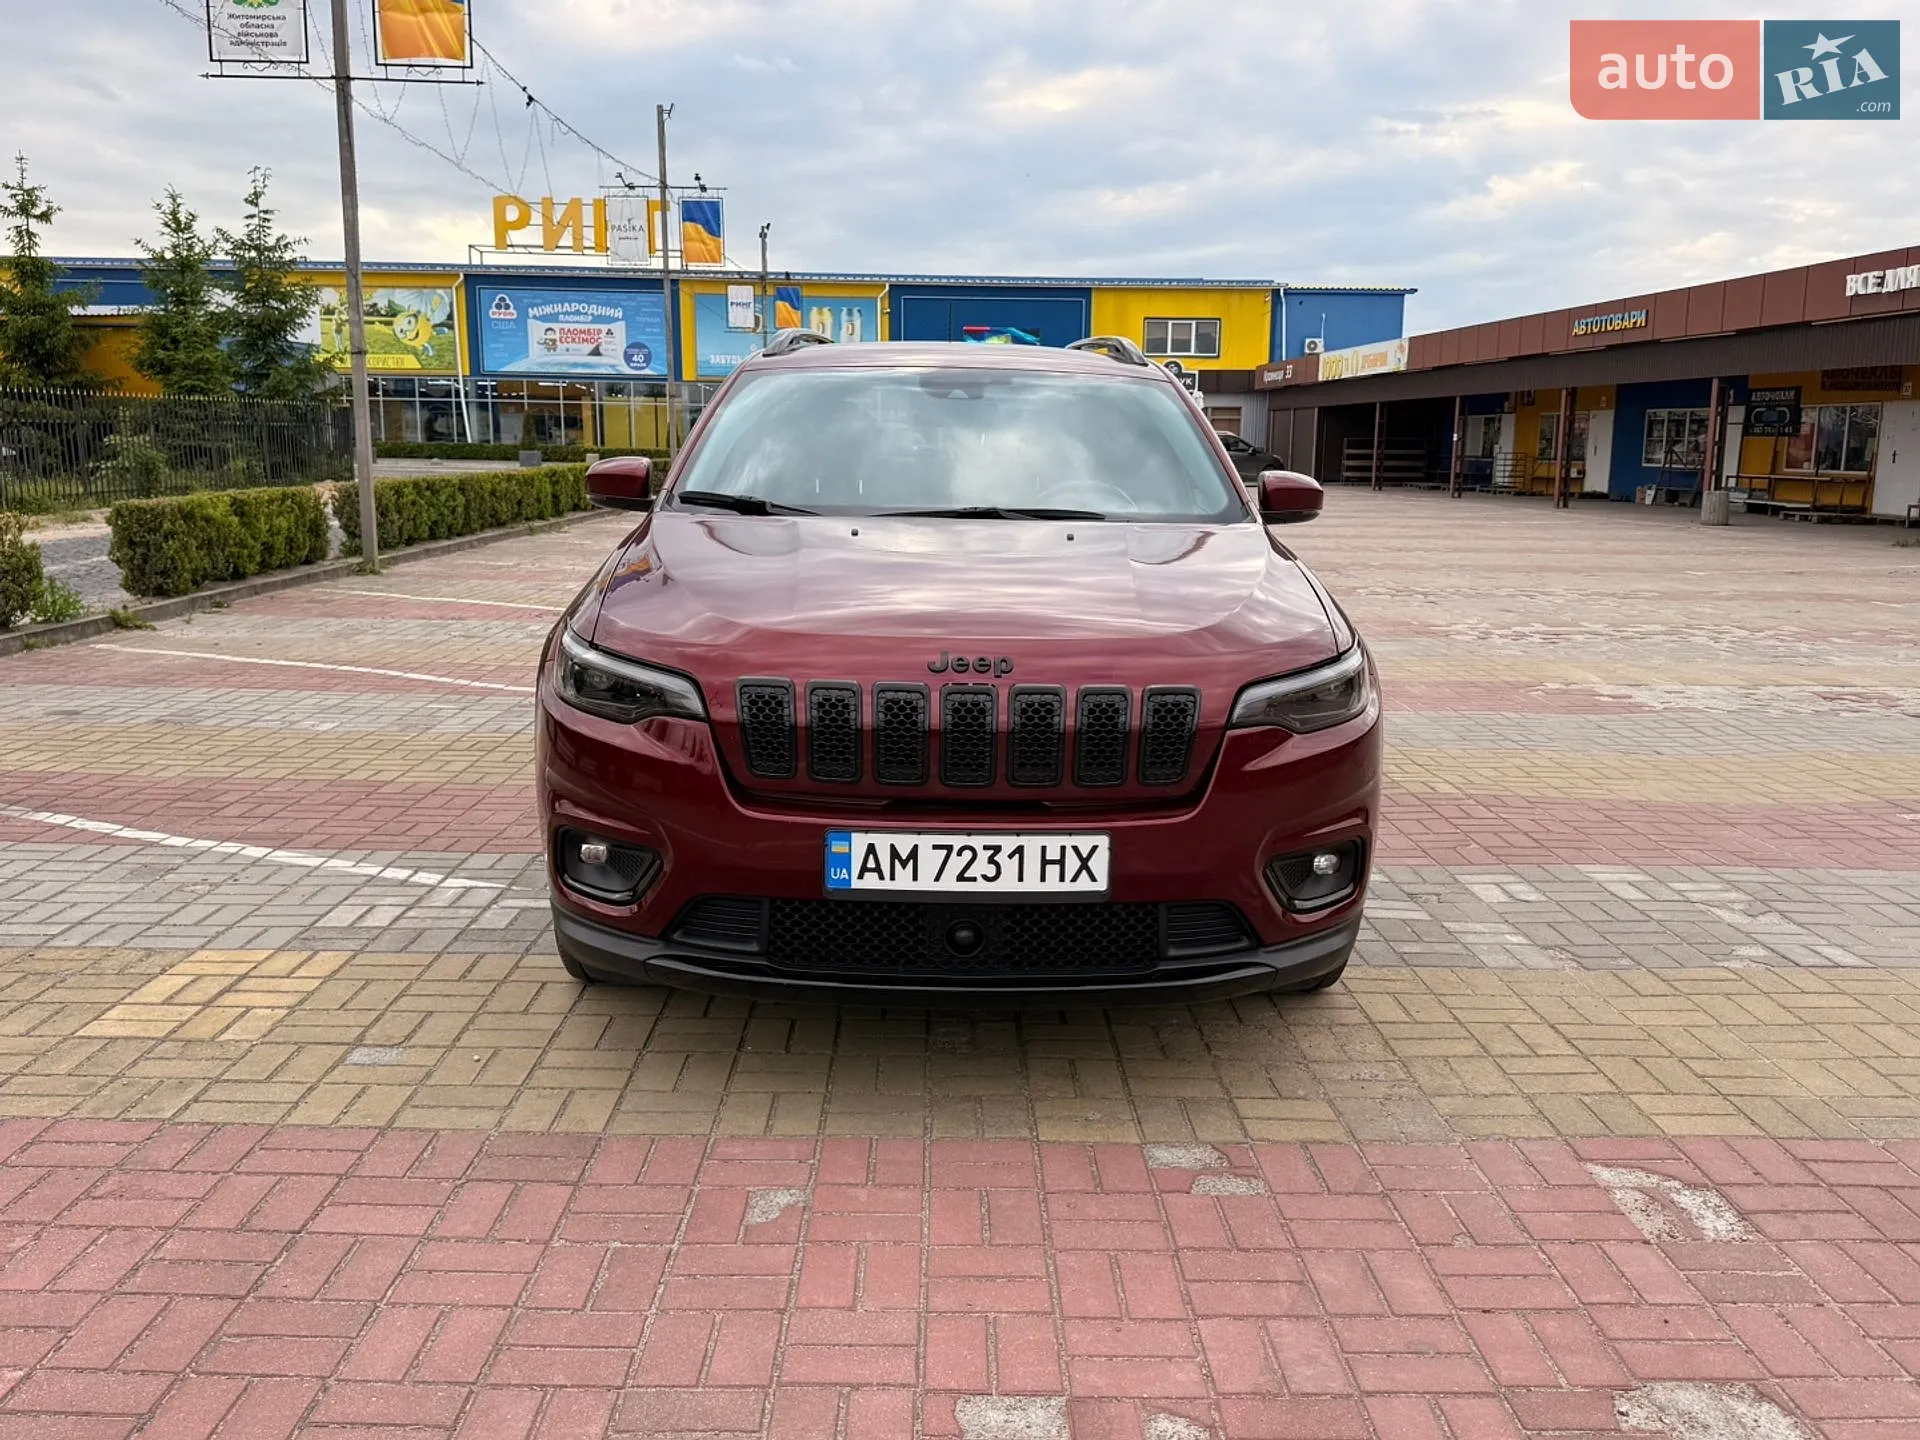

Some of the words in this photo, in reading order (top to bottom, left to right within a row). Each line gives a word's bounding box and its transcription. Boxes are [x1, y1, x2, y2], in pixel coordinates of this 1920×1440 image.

[227, 13, 287, 21] Житомирська
[239, 21, 275, 29] обласна
[229, 39, 288, 47] адміністрація
[610, 222, 645, 233] PASIKA
[729, 301, 752, 309] РИНГ
[528, 302, 623, 319] МІЖНАРОДНИЙ
[558, 314, 593, 322] ПЛОМБІР
[1571, 309, 1648, 337] АВТОТОВАРИ
[559, 327, 602, 337] ПЛОМБІР
[632, 354, 644, 363] 40
[927, 650, 1015, 679] Jeep
[857, 842, 920, 882] AM
[932, 844, 1025, 883] 7231
[1039, 844, 1100, 883] HX
[831, 868, 849, 880] UA
